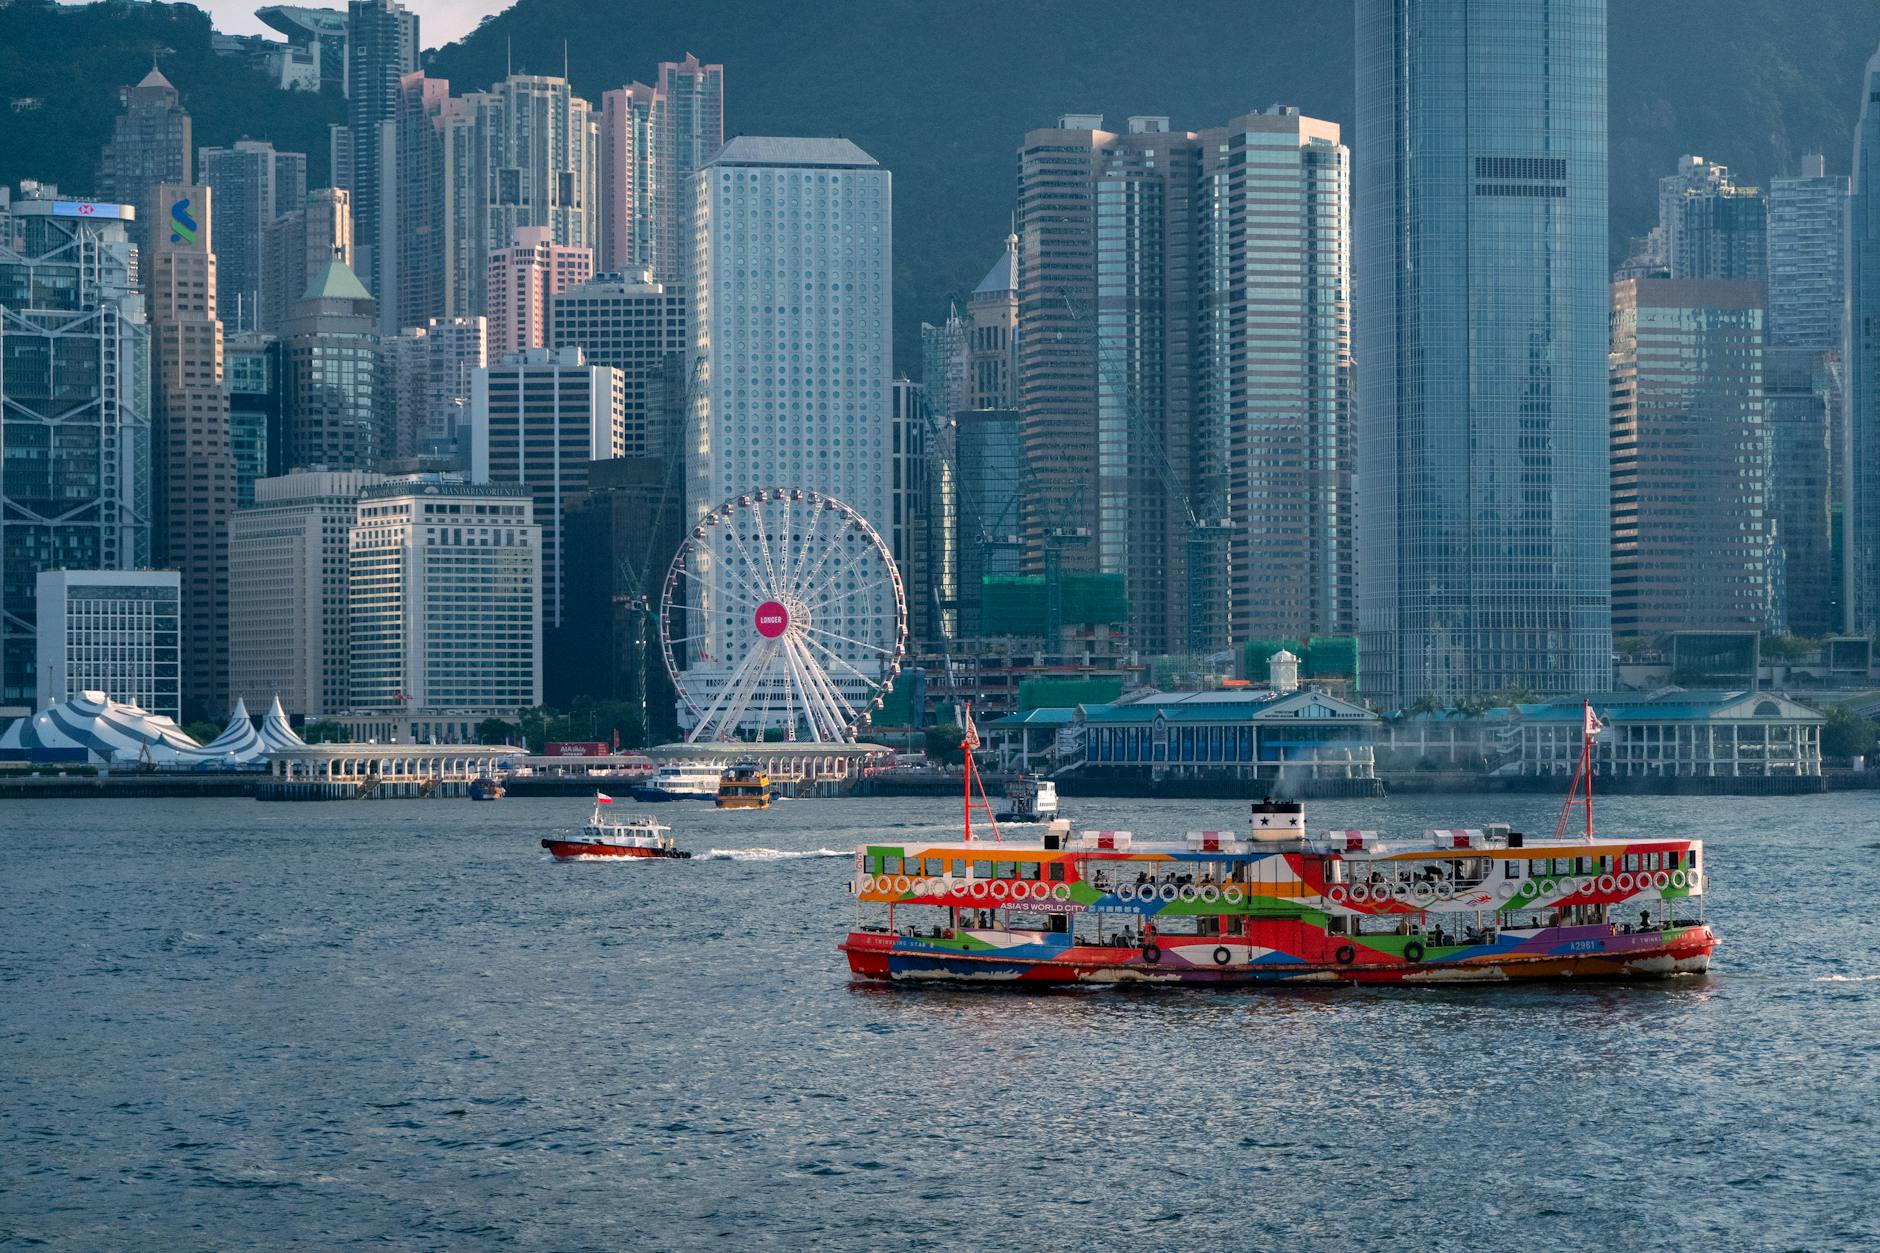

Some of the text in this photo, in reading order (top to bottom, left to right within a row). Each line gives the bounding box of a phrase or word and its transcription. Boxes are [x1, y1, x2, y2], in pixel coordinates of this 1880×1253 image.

[441, 487, 484, 496] MANDARIN
[760, 616, 782, 624] LONGER
[1000, 902, 1086, 912] ASIA'S WORLD CITY
